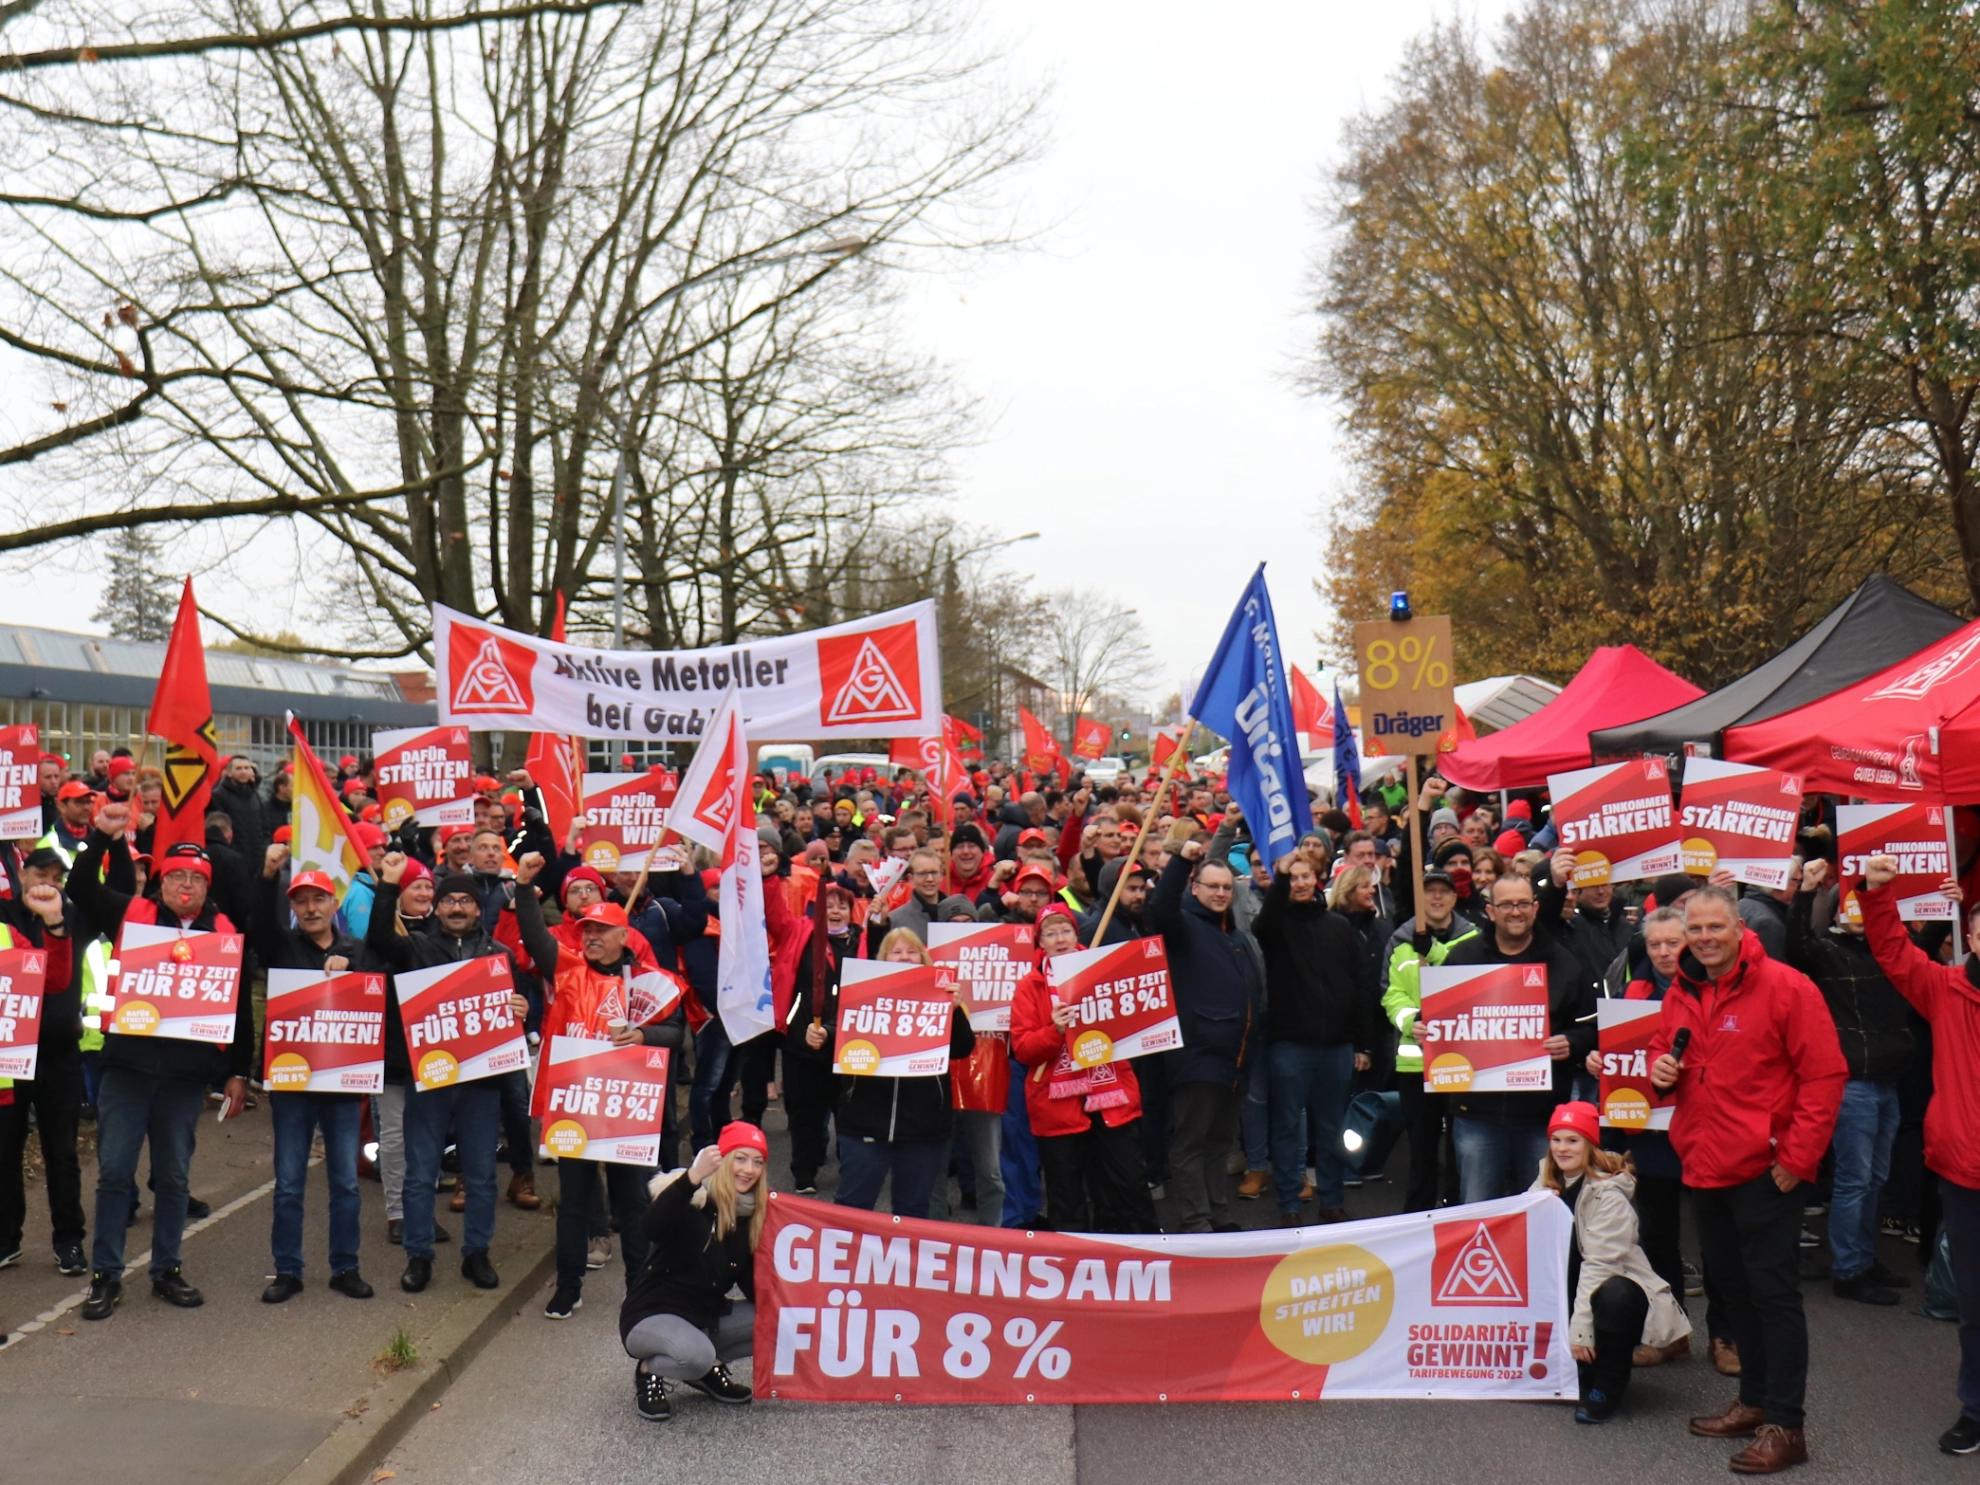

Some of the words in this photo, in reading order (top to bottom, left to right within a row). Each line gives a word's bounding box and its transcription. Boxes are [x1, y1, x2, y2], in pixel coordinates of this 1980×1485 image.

[552, 653, 642, 690] Aktive
[652, 649, 788, 691] Metaller
[1365, 635, 1449, 691] 8%
[586, 693, 634, 731] bei
[1373, 711, 1444, 738] Dräger
[401, 745, 447, 763] DAFÜR
[378, 760, 469, 786] STREITEN
[1853, 766, 1875, 783] GUTES
[1875, 768, 1897, 785] LEBEN
[415, 779, 456, 800] WIR
[611, 792, 656, 807] DAFÜR
[1602, 794, 1670, 816] EINKOMMEN
[1726, 800, 1796, 822] EINKOMMEN
[1561, 805, 1672, 844] STÄRKEN!
[1679, 804, 1793, 843] STÄRKEN!
[593, 848, 612, 859] 8%
[1884, 841, 1947, 853] EINKOMMEN
[1841, 849, 1949, 876] STKEN!
[1573, 870, 1592, 882] FÜR
[960, 943, 1009, 960] DAFÜR
[158, 961, 176, 975] ES
[178, 964, 204, 978] IST
[205, 965, 239, 980] ZEIT
[121, 968, 174, 997] FÜR
[971, 981, 1017, 1001] WIR
[1095, 982, 1112, 999] ES
[1114, 977, 1135, 994] IST
[1138, 970, 1168, 988] ZEIT
[438, 1000, 457, 1017] ES
[458, 995, 481, 1013] IST
[483, 988, 514, 1007] ZEIT
[875, 997, 894, 1012] ES
[895, 999, 919, 1013] IST
[920, 1001, 951, 1015] ZEIT
[1068, 995, 1115, 1028] FÜR
[1472, 1005, 1546, 1017] EINKOMMEN
[121, 1016, 155, 1024] STREITEN
[126, 1009, 150, 1017] DAFÜR
[314, 1009, 383, 1022] EINKOMMEN
[841, 1004, 892, 1035] FÜR
[269, 1015, 382, 1045] STÄRKEN!
[410, 1014, 460, 1048] FÜR
[1426, 1013, 1544, 1042] STÄRKEN!
[847, 1048, 871, 1056] DAFÜR
[1077, 1043, 1109, 1059] STREITEN
[1080, 1037, 1103, 1050] DAFÜR
[425, 1058, 448, 1071] DAFÜR
[843, 1055, 875, 1063] STREITEN
[851, 1062, 868, 1070] WIR!
[1087, 1053, 1104, 1063] WIR!
[272, 1073, 290, 1084] FÜR
[422, 1063, 455, 1079] STREITEN
[431, 1072, 450, 1084] WIR!
[1433, 1073, 1452, 1085] FÜR
[585, 1077, 603, 1092] ES
[605, 1079, 630, 1094] IST
[631, 1081, 663, 1098] ZEIT
[549, 1083, 600, 1116] FÜR
[1608, 1108, 1628, 1119] FÜR
[550, 1137, 582, 1145] STREITEN
[554, 1129, 578, 1137] DAFÜR
[558, 1144, 575, 1152] WIR!
[773, 1222, 1173, 1301] GEMEINSAM
[1290, 1266, 1367, 1298] DAFÜR
[1275, 1284, 1381, 1320] STREITEN
[773, 1288, 921, 1377] FÜR
[1302, 1311, 1355, 1338] WIR!
[1407, 1321, 1530, 1342] SOLIDARITÄT
[1408, 1368, 1496, 1379] TARIFBEWEGUNG
[1497, 1369, 1524, 1380] 2022
